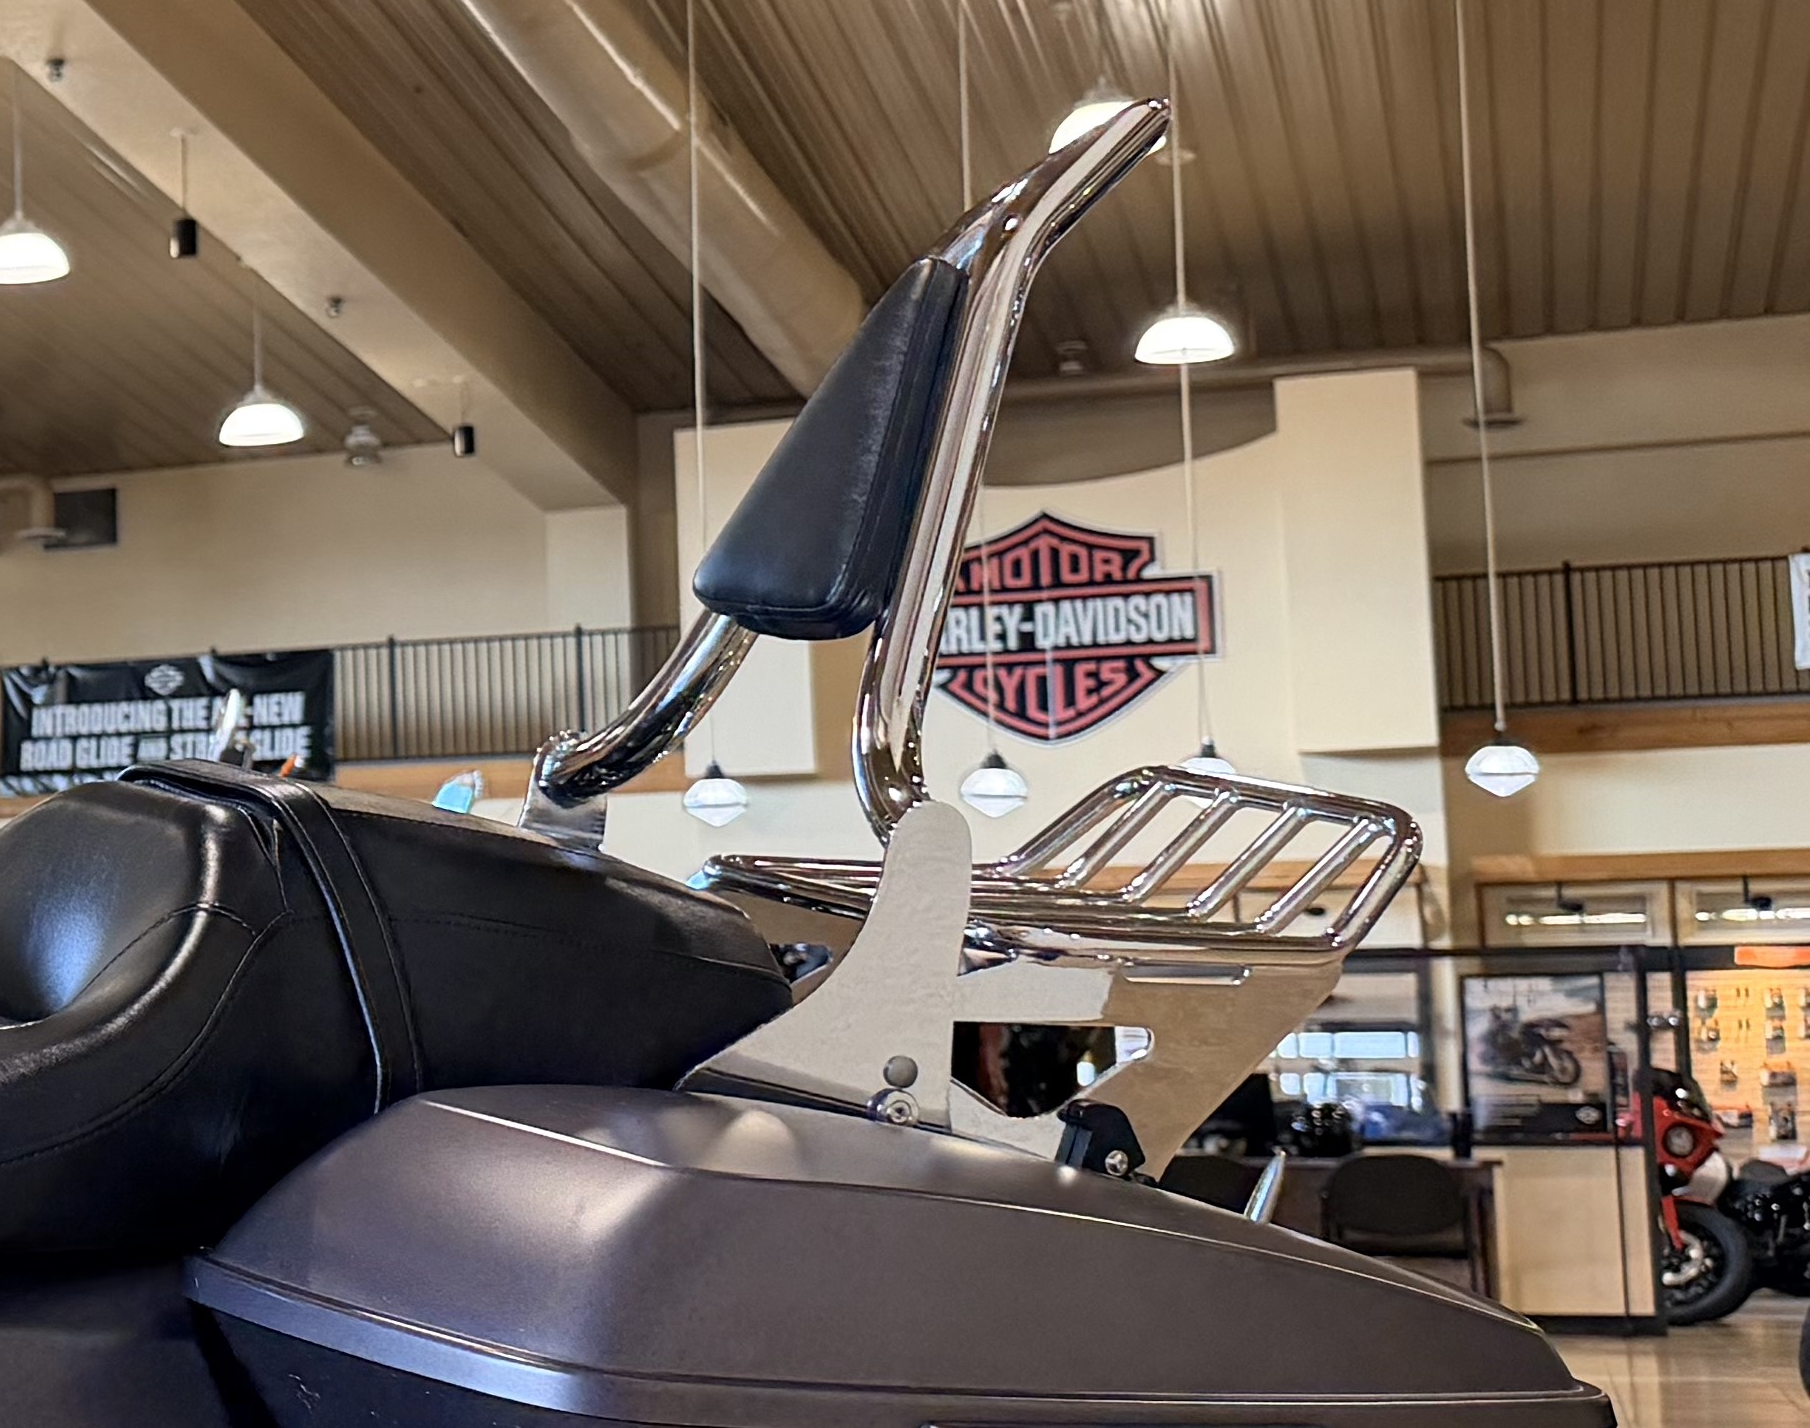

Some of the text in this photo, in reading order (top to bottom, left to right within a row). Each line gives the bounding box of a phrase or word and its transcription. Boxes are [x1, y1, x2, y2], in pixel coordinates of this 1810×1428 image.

[970, 534, 1124, 591] MOTOR
[972, 659, 1126, 723] CYCLES
[30, 699, 168, 738] INTRODUCING
[172, 696, 211, 730] THE
[20, 739, 73, 772] ROAD
[75, 736, 135, 769] GLIDE
[249, 726, 312, 761] GLIDE
